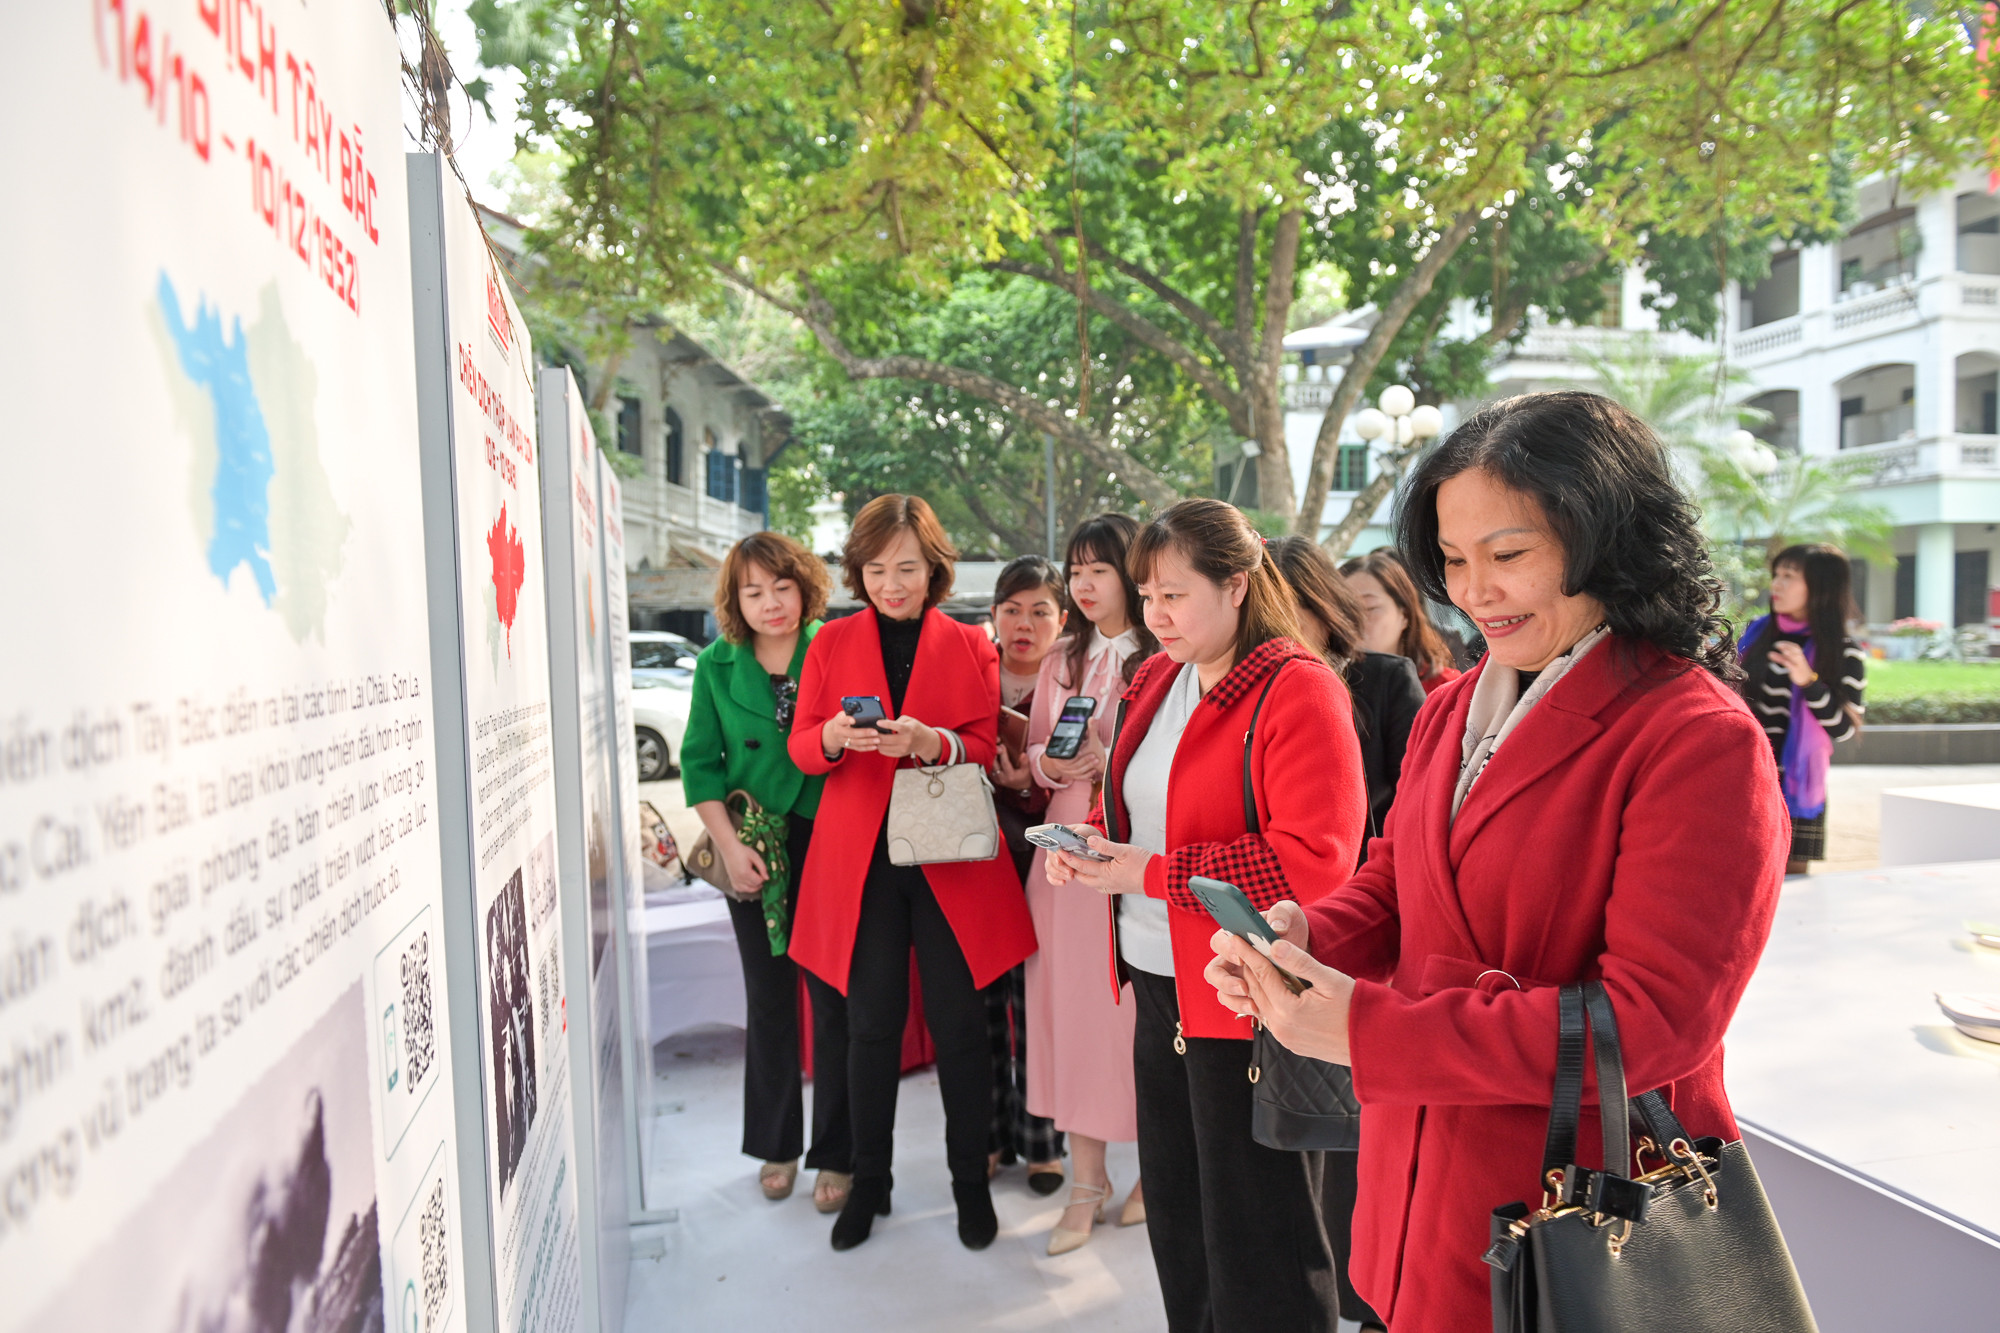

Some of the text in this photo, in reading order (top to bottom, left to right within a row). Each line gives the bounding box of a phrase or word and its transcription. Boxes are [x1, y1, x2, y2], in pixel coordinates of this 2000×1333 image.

[285, 49, 333, 185] TÂY
[338, 122, 380, 247] BẮC
[246, 136, 361, 320] 10/12/1952)
[350, 676, 365, 711] Lai
[391, 672, 407, 702] Sơn
[393, 718, 401, 747] 6
[415, 759, 425, 788] 30
